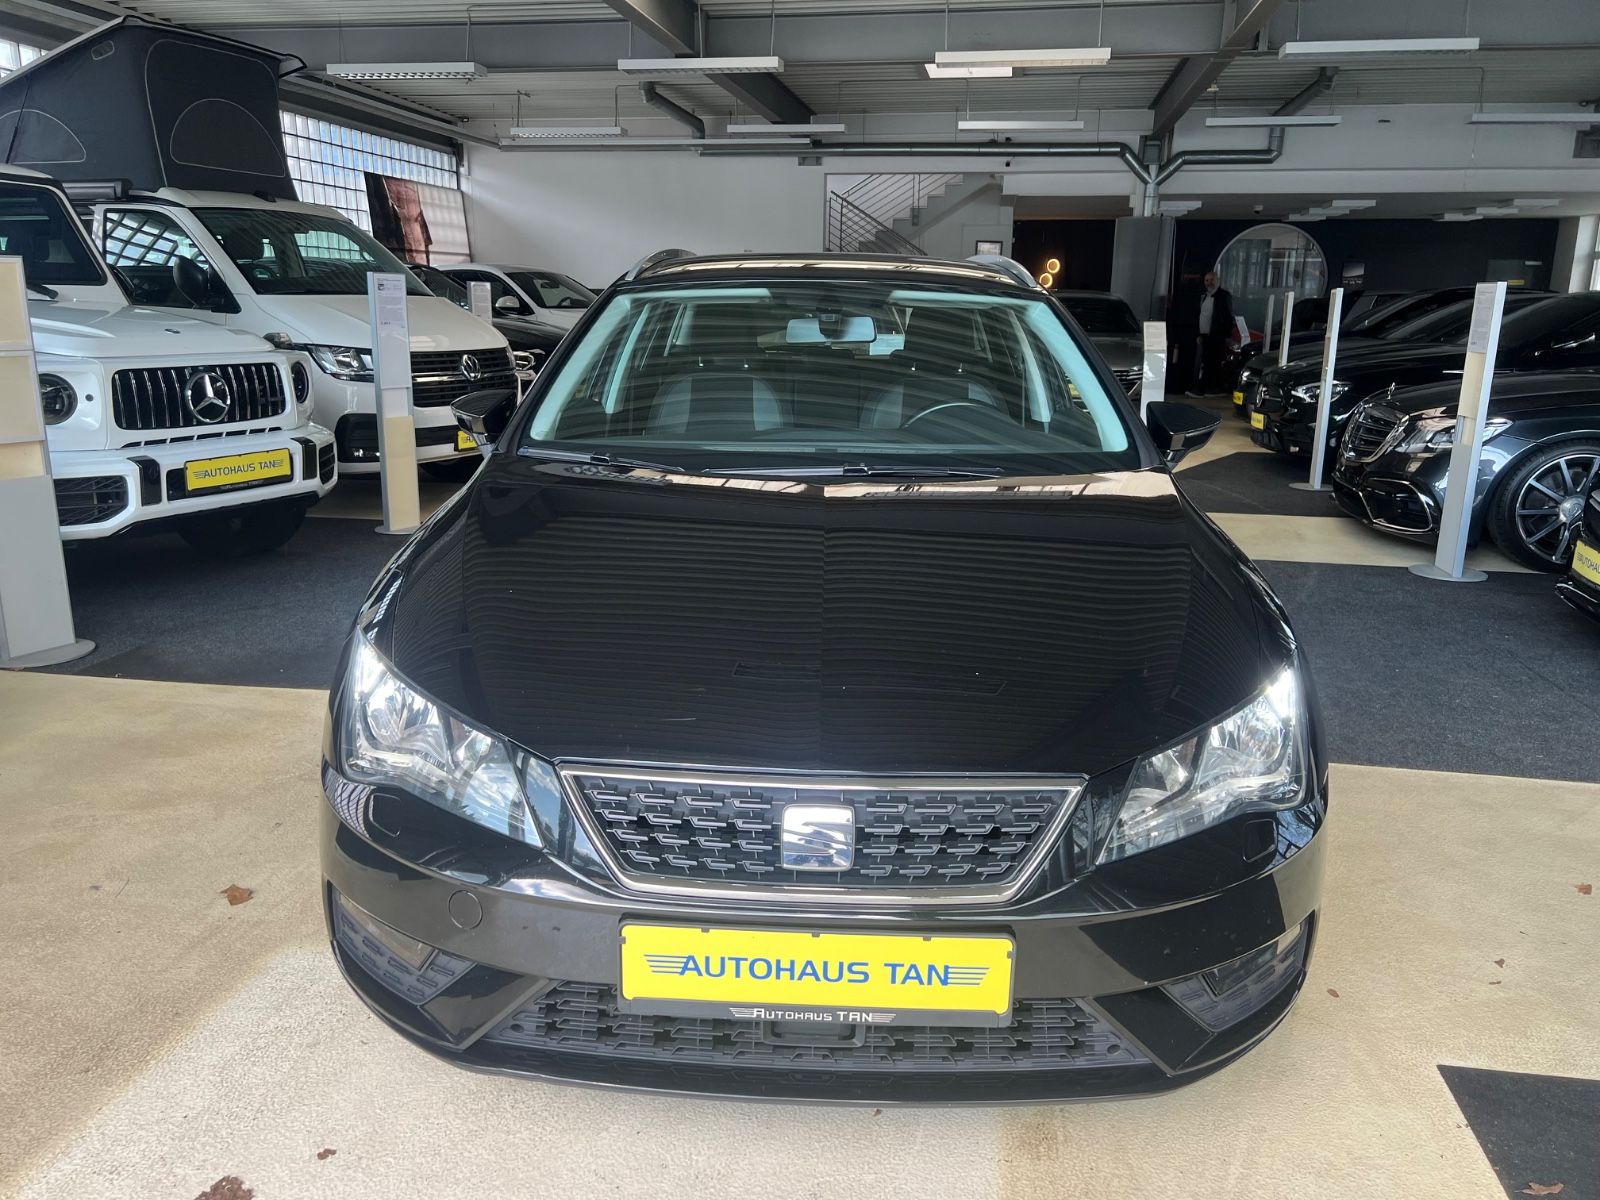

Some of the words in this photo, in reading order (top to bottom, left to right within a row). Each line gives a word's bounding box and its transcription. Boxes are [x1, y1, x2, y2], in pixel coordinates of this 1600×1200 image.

[203, 463, 256, 478] AUTOHAUS
[258, 460, 276, 470] TAN
[679, 955, 870, 984] AUTOHAUS
[884, 962, 950, 986] TAN
[753, 1007, 833, 1021] AUTOHAUS
[837, 1011, 873, 1023] TAN
